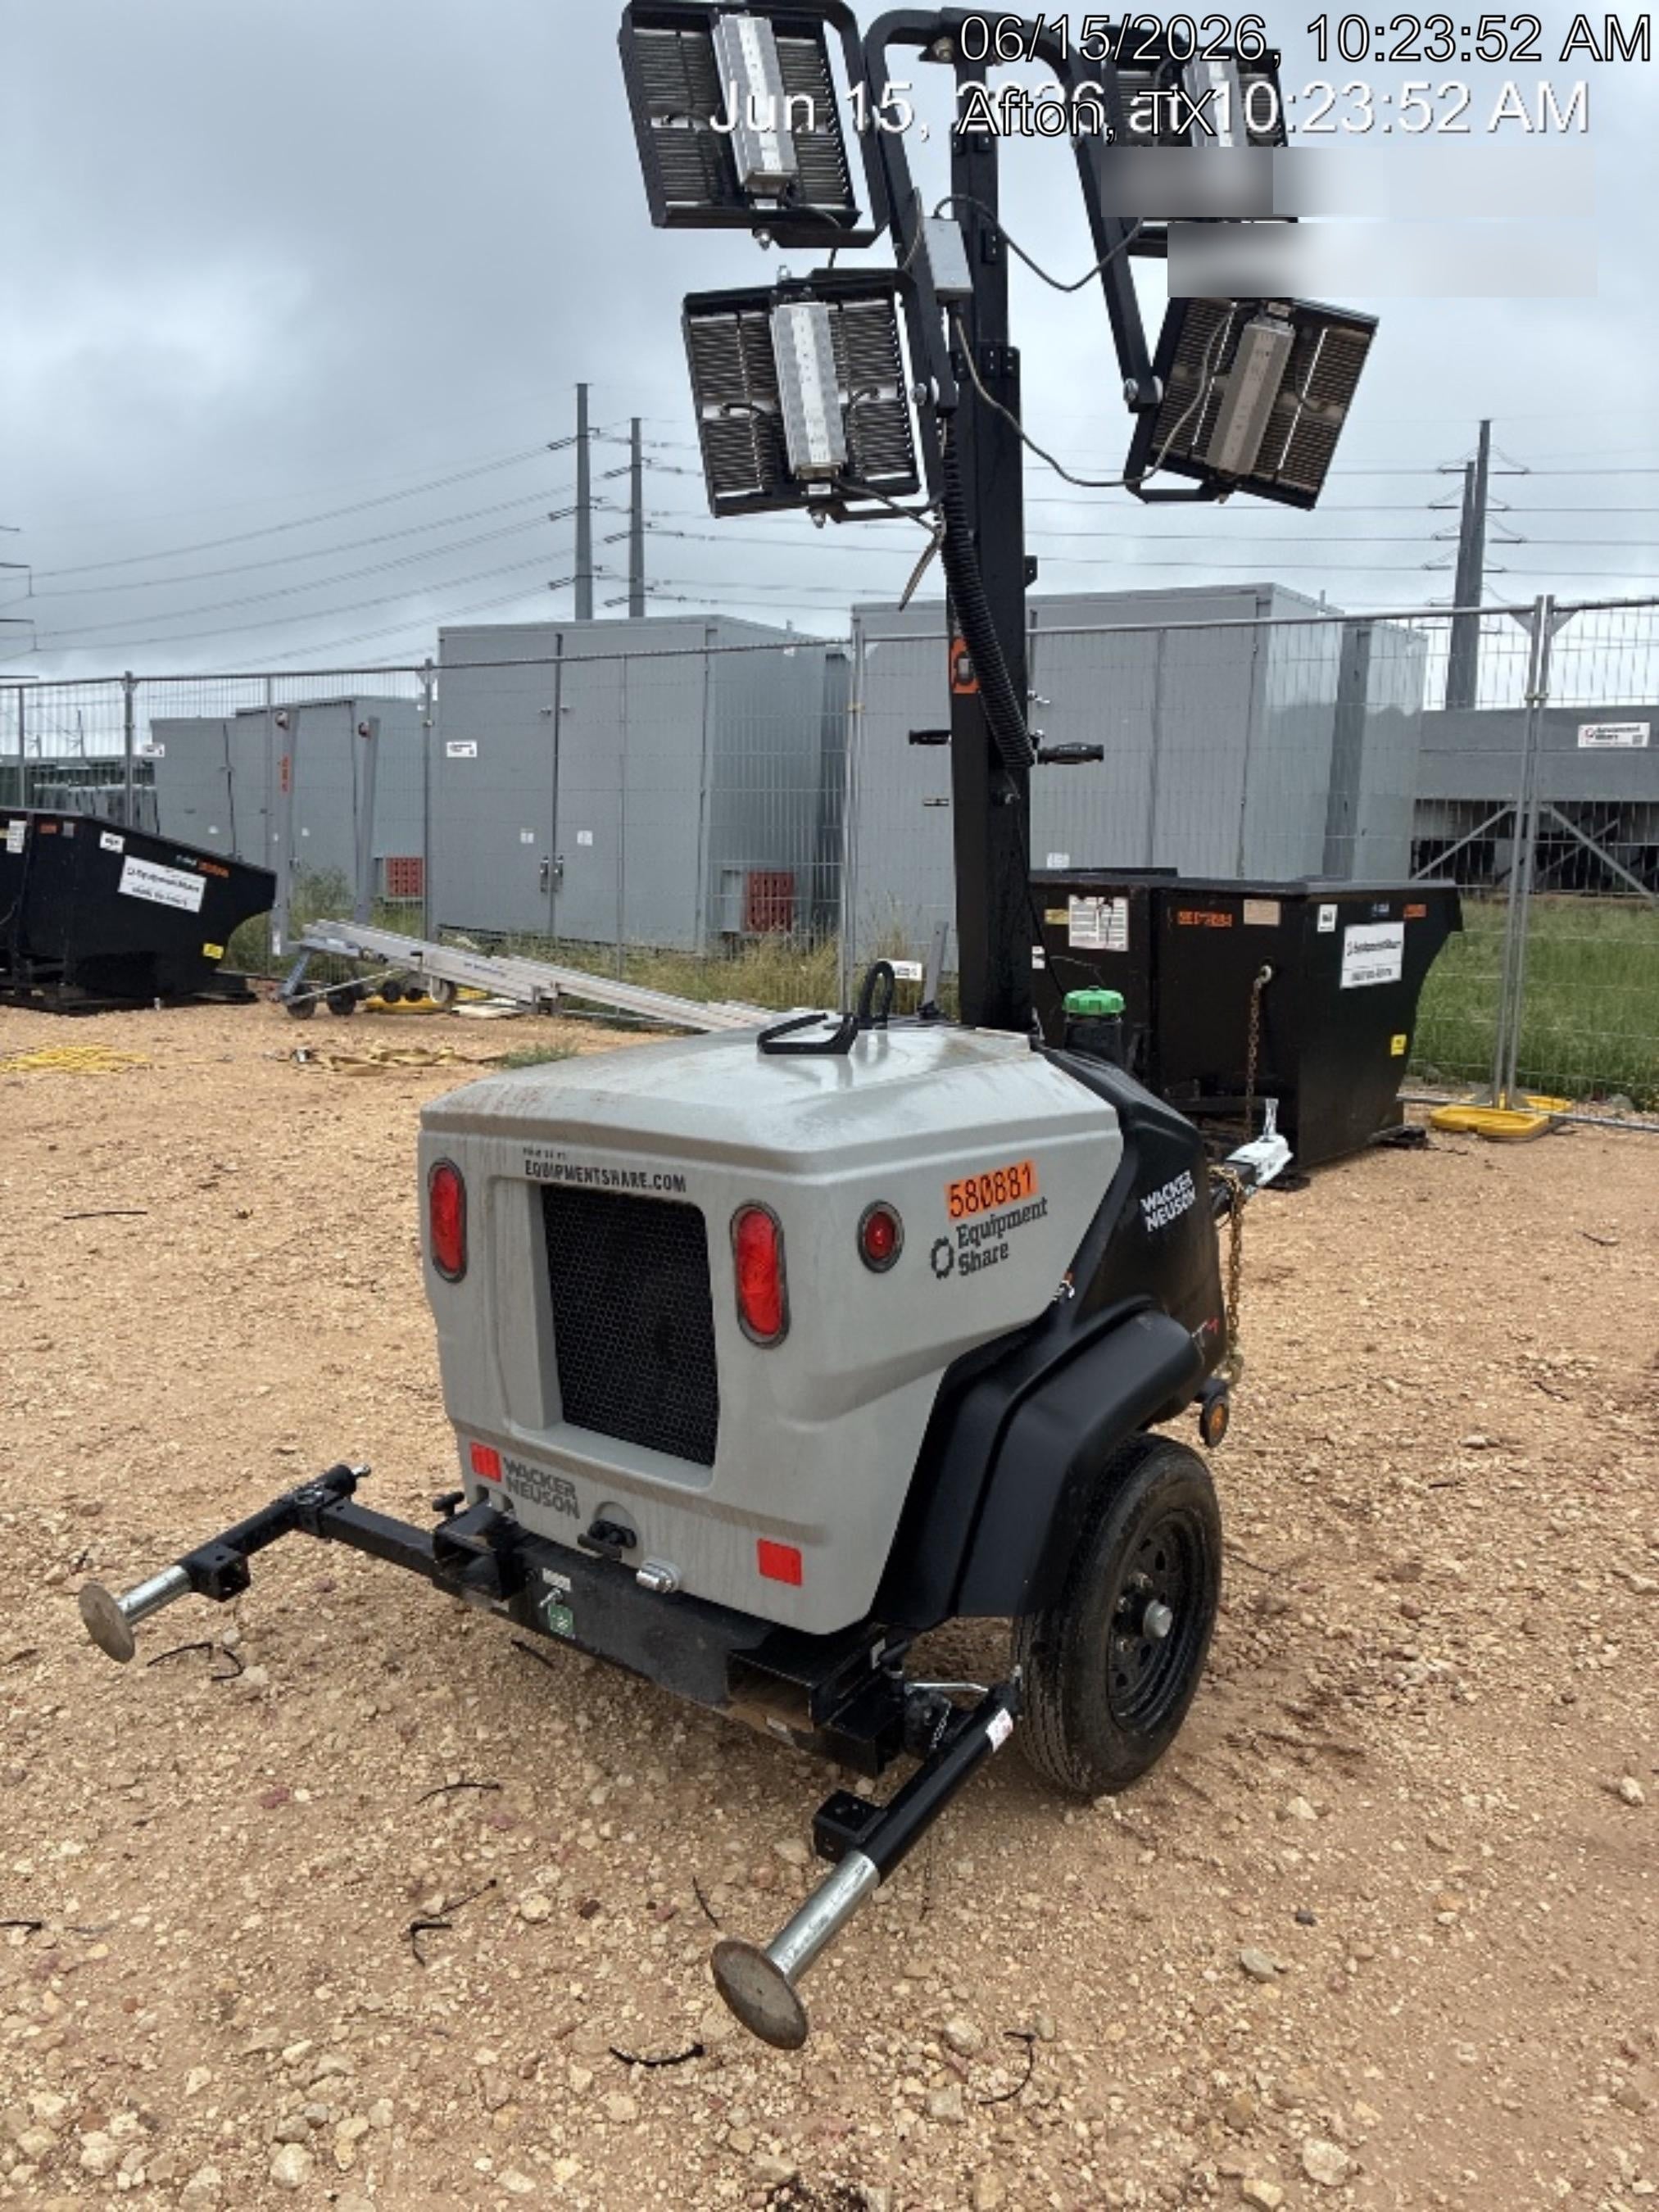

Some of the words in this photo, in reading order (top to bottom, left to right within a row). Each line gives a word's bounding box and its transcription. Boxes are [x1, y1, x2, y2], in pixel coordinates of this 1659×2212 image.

[525, 1159, 687, 1193] EQUIPMENTSHARE.COM
[950, 1162, 1031, 1218] 580881
[1140, 1169, 1193, 1213] WACKER
[955, 1196, 1048, 1249] Equipment
[1145, 1185, 1195, 1232] NEUSON
[959, 1241, 1009, 1276] Share
[503, 1457, 575, 1500] WACKER
[506, 1474, 580, 1520] NEUSON
